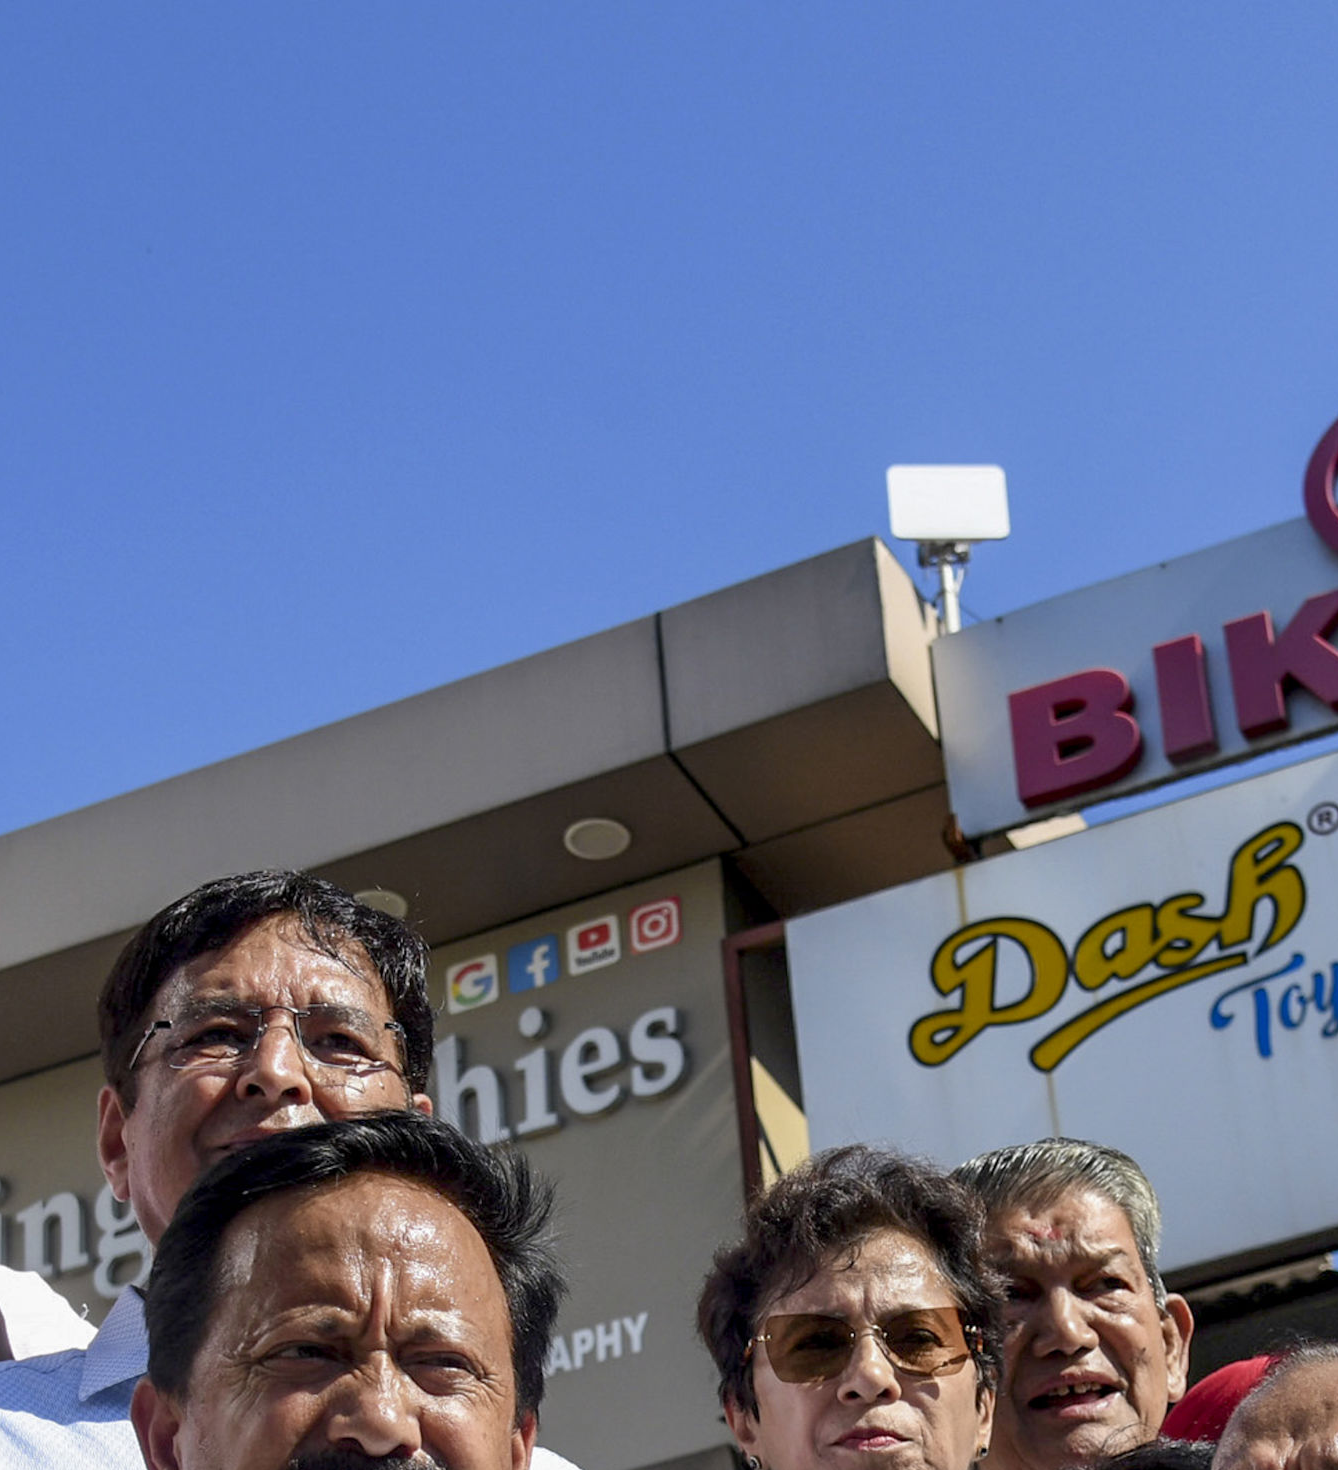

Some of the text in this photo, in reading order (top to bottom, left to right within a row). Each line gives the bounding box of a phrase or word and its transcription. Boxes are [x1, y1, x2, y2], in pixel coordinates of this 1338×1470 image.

[908, 820, 1307, 1069] Dash
[434, 1005, 686, 1146] hies
[544, 1311, 649, 1379] APHY
